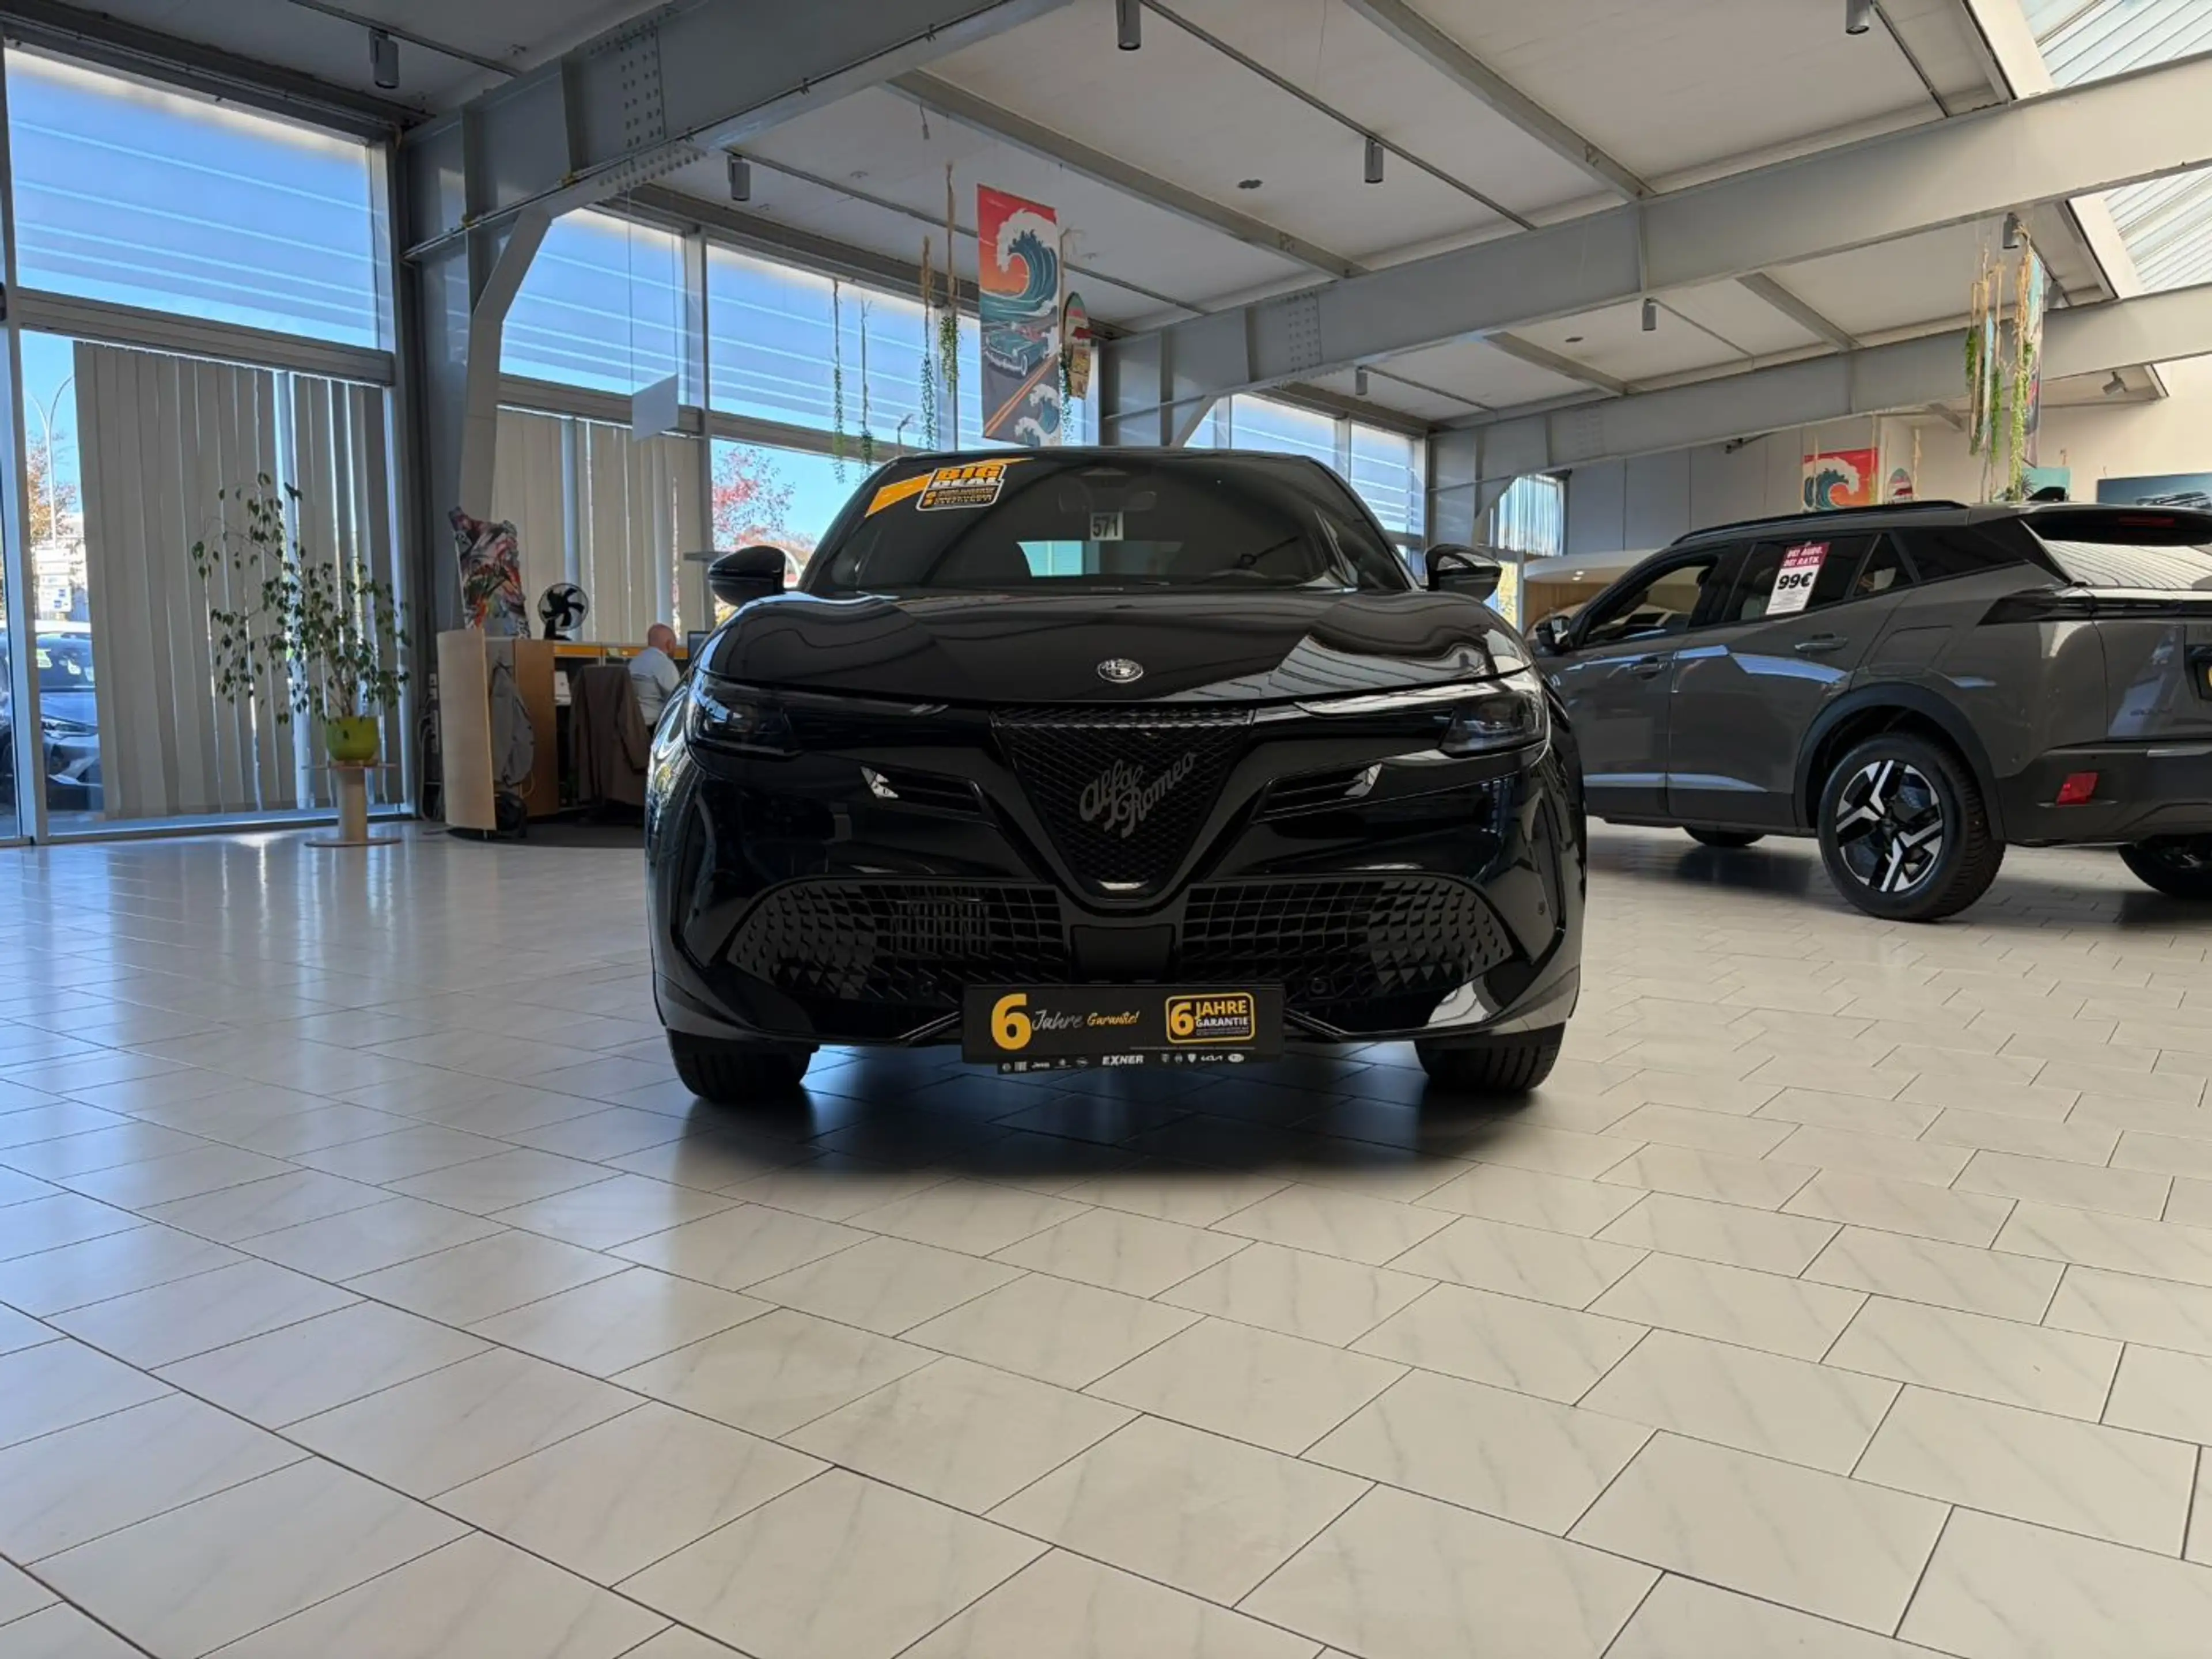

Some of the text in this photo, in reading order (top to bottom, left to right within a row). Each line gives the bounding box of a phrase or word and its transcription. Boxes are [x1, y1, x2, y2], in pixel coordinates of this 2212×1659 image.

[935, 465, 1001, 480] BIG
[1092, 514, 1118, 537] 571
[1778, 572, 1813, 590] 99€
[1080, 751, 1198, 838] Alfa Romeo
[991, 993, 1032, 1050] 6
[1032, 1009, 1085, 1031] Jahre
[1171, 1002, 1194, 1036] 6
[1195, 999, 1248, 1020] JAHRE
[1196, 1016, 1249, 1028] GARANTIE
[1101, 1054, 1145, 1066] EXNER
